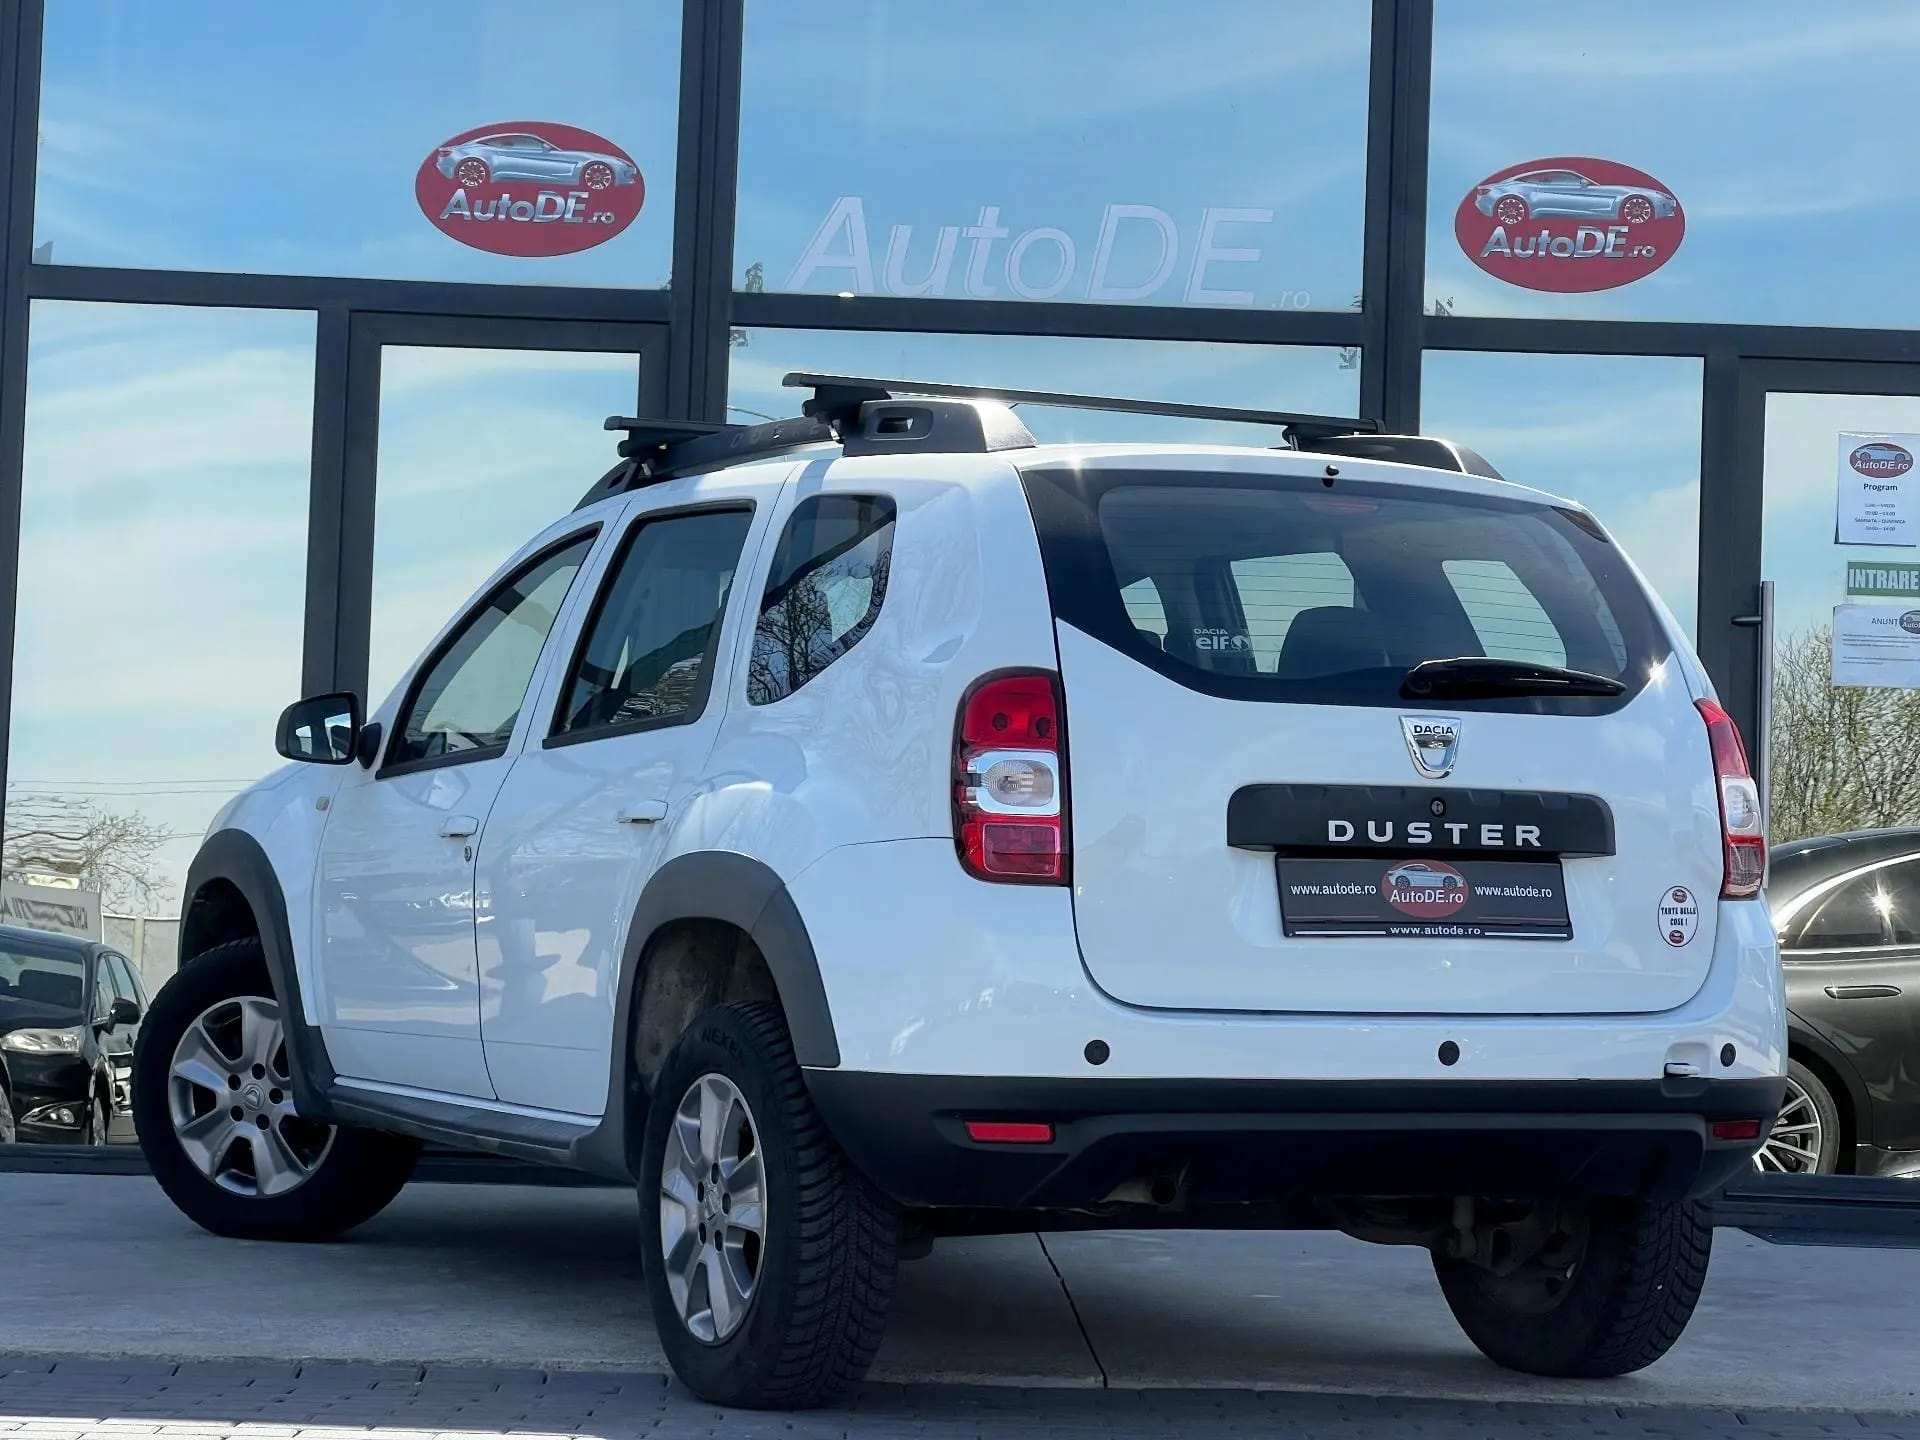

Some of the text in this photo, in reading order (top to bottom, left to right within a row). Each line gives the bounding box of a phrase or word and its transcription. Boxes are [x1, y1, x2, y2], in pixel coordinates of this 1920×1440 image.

[1854, 460, 1909, 470] AutoDE.ro
[1863, 483, 1898, 491] Program
[1848, 568, 1919, 590] INTRARE
[1195, 635, 1230, 650] elf
[1413, 725, 1454, 735] DACIA
[1328, 820, 1542, 847] DUSTER
[1291, 882, 1377, 895] www.autode.ro
[1475, 884, 1553, 898] www.autode.ro
[1390, 889, 1464, 904] AutoDE.ro
[1670, 918, 1683, 926] COSE
[1390, 925, 1481, 936] www.autode.ro
